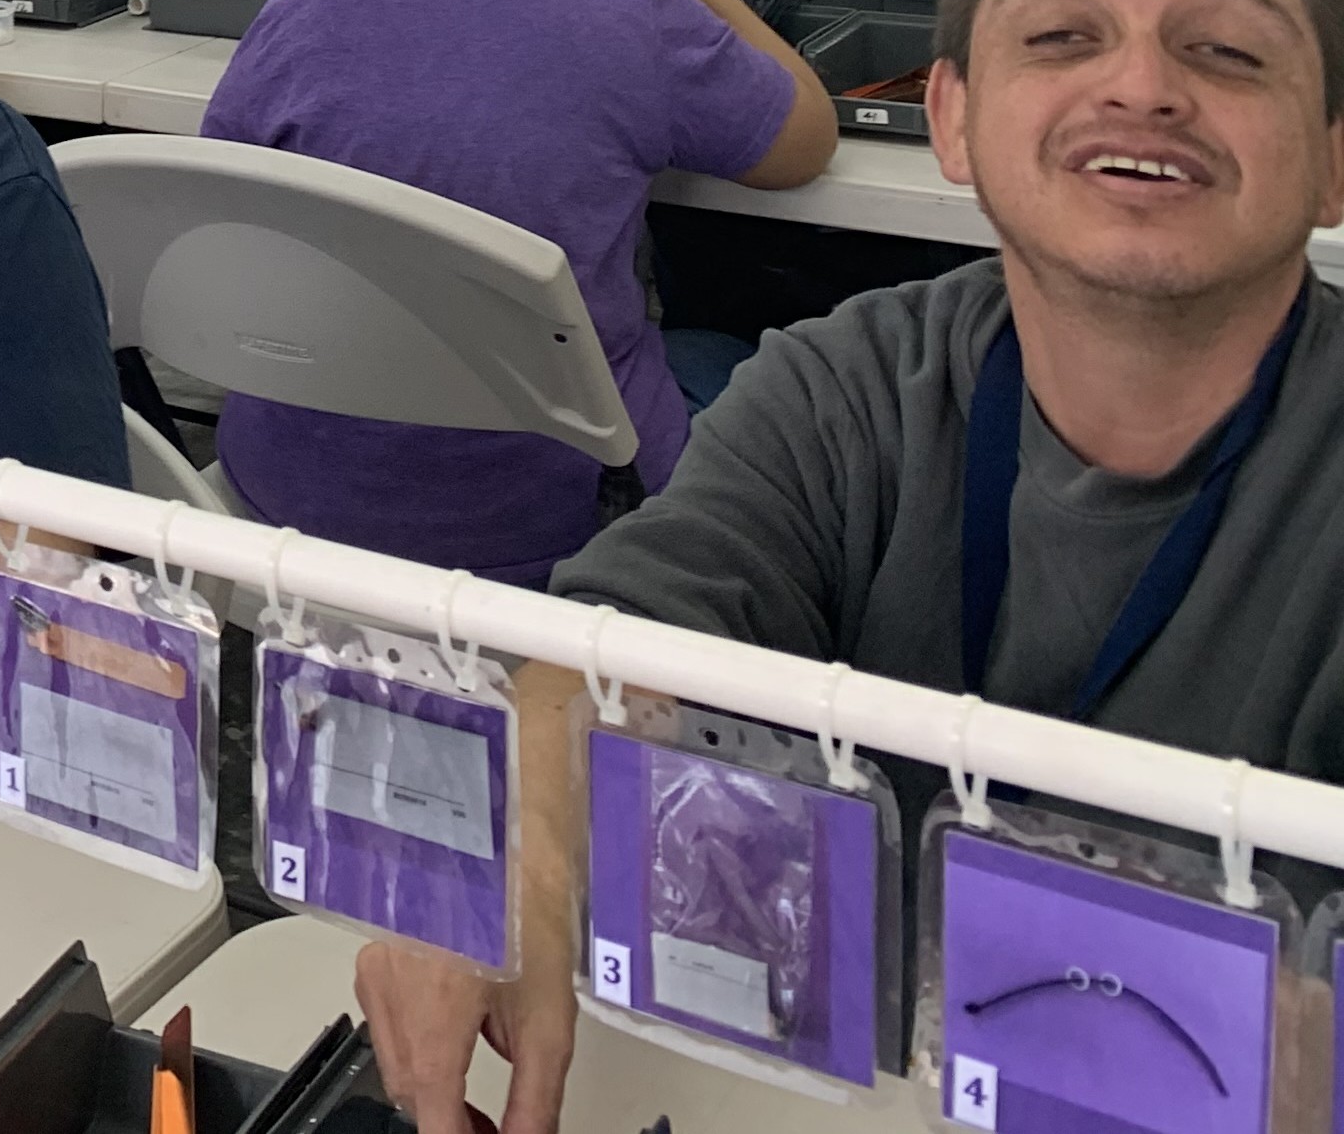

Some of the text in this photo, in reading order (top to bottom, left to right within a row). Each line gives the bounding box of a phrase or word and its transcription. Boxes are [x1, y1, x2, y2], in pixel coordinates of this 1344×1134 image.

[5, 767, 20, 793] 1
[280, 856, 298, 884] 2
[604, 955, 622, 984] 3
[964, 1077, 988, 1106] 4
